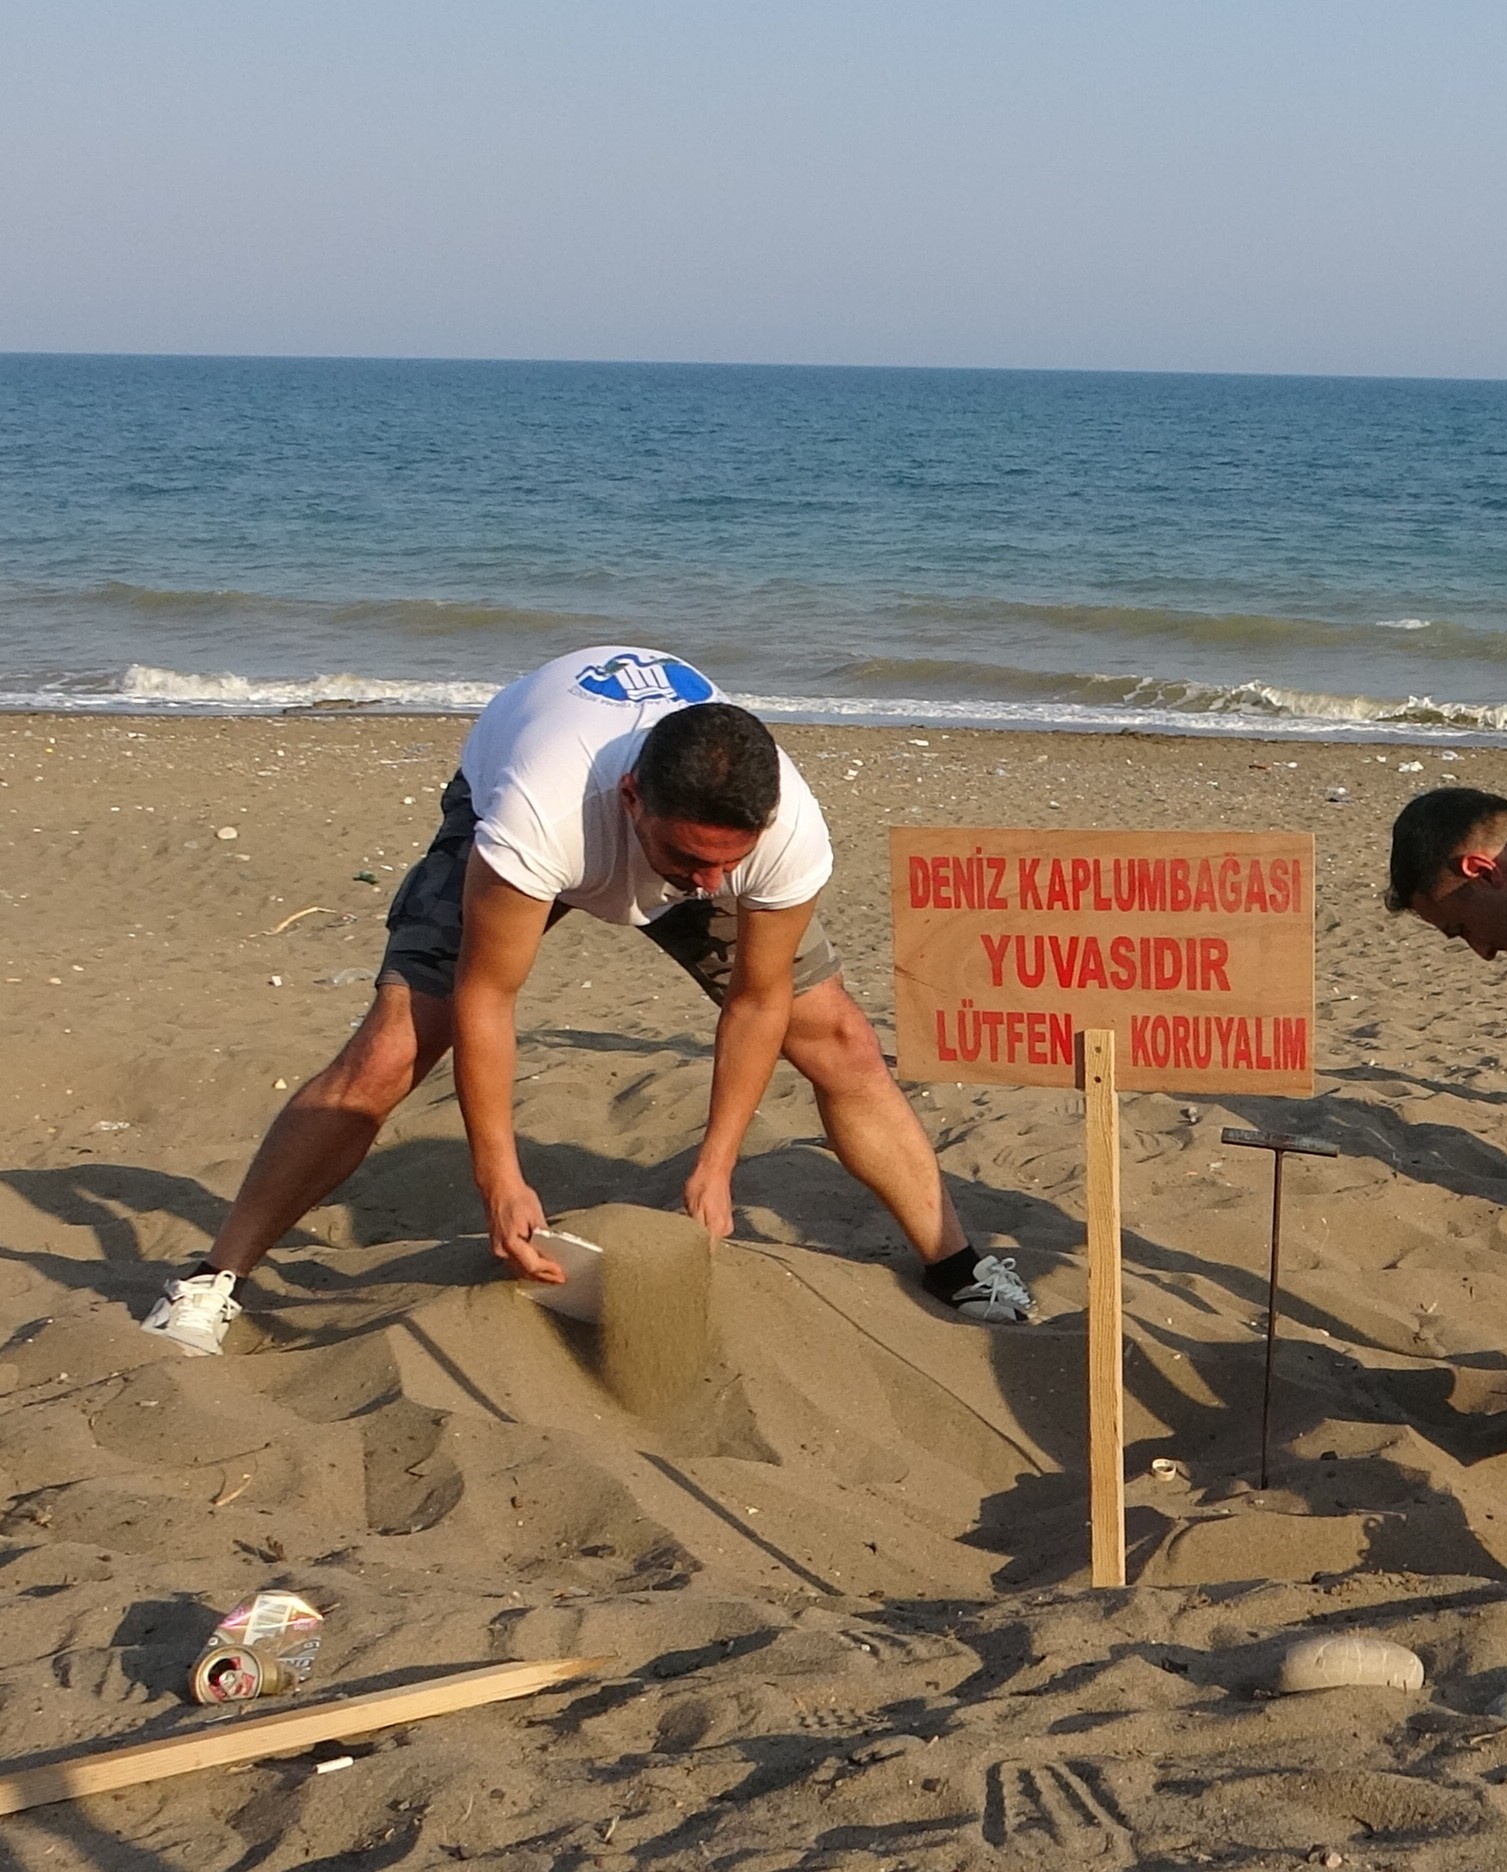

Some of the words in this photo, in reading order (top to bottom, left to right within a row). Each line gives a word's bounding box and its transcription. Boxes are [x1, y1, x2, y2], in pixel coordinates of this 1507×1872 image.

[909, 847, 1008, 910] DENİZ
[1018, 852, 1301, 913] KAPLUMBAĞASI
[980, 934, 1232, 991] YUVASIDIR
[936, 999, 1073, 1065] LÜTFEN
[1130, 1015, 1306, 1070] KORUYALIM
